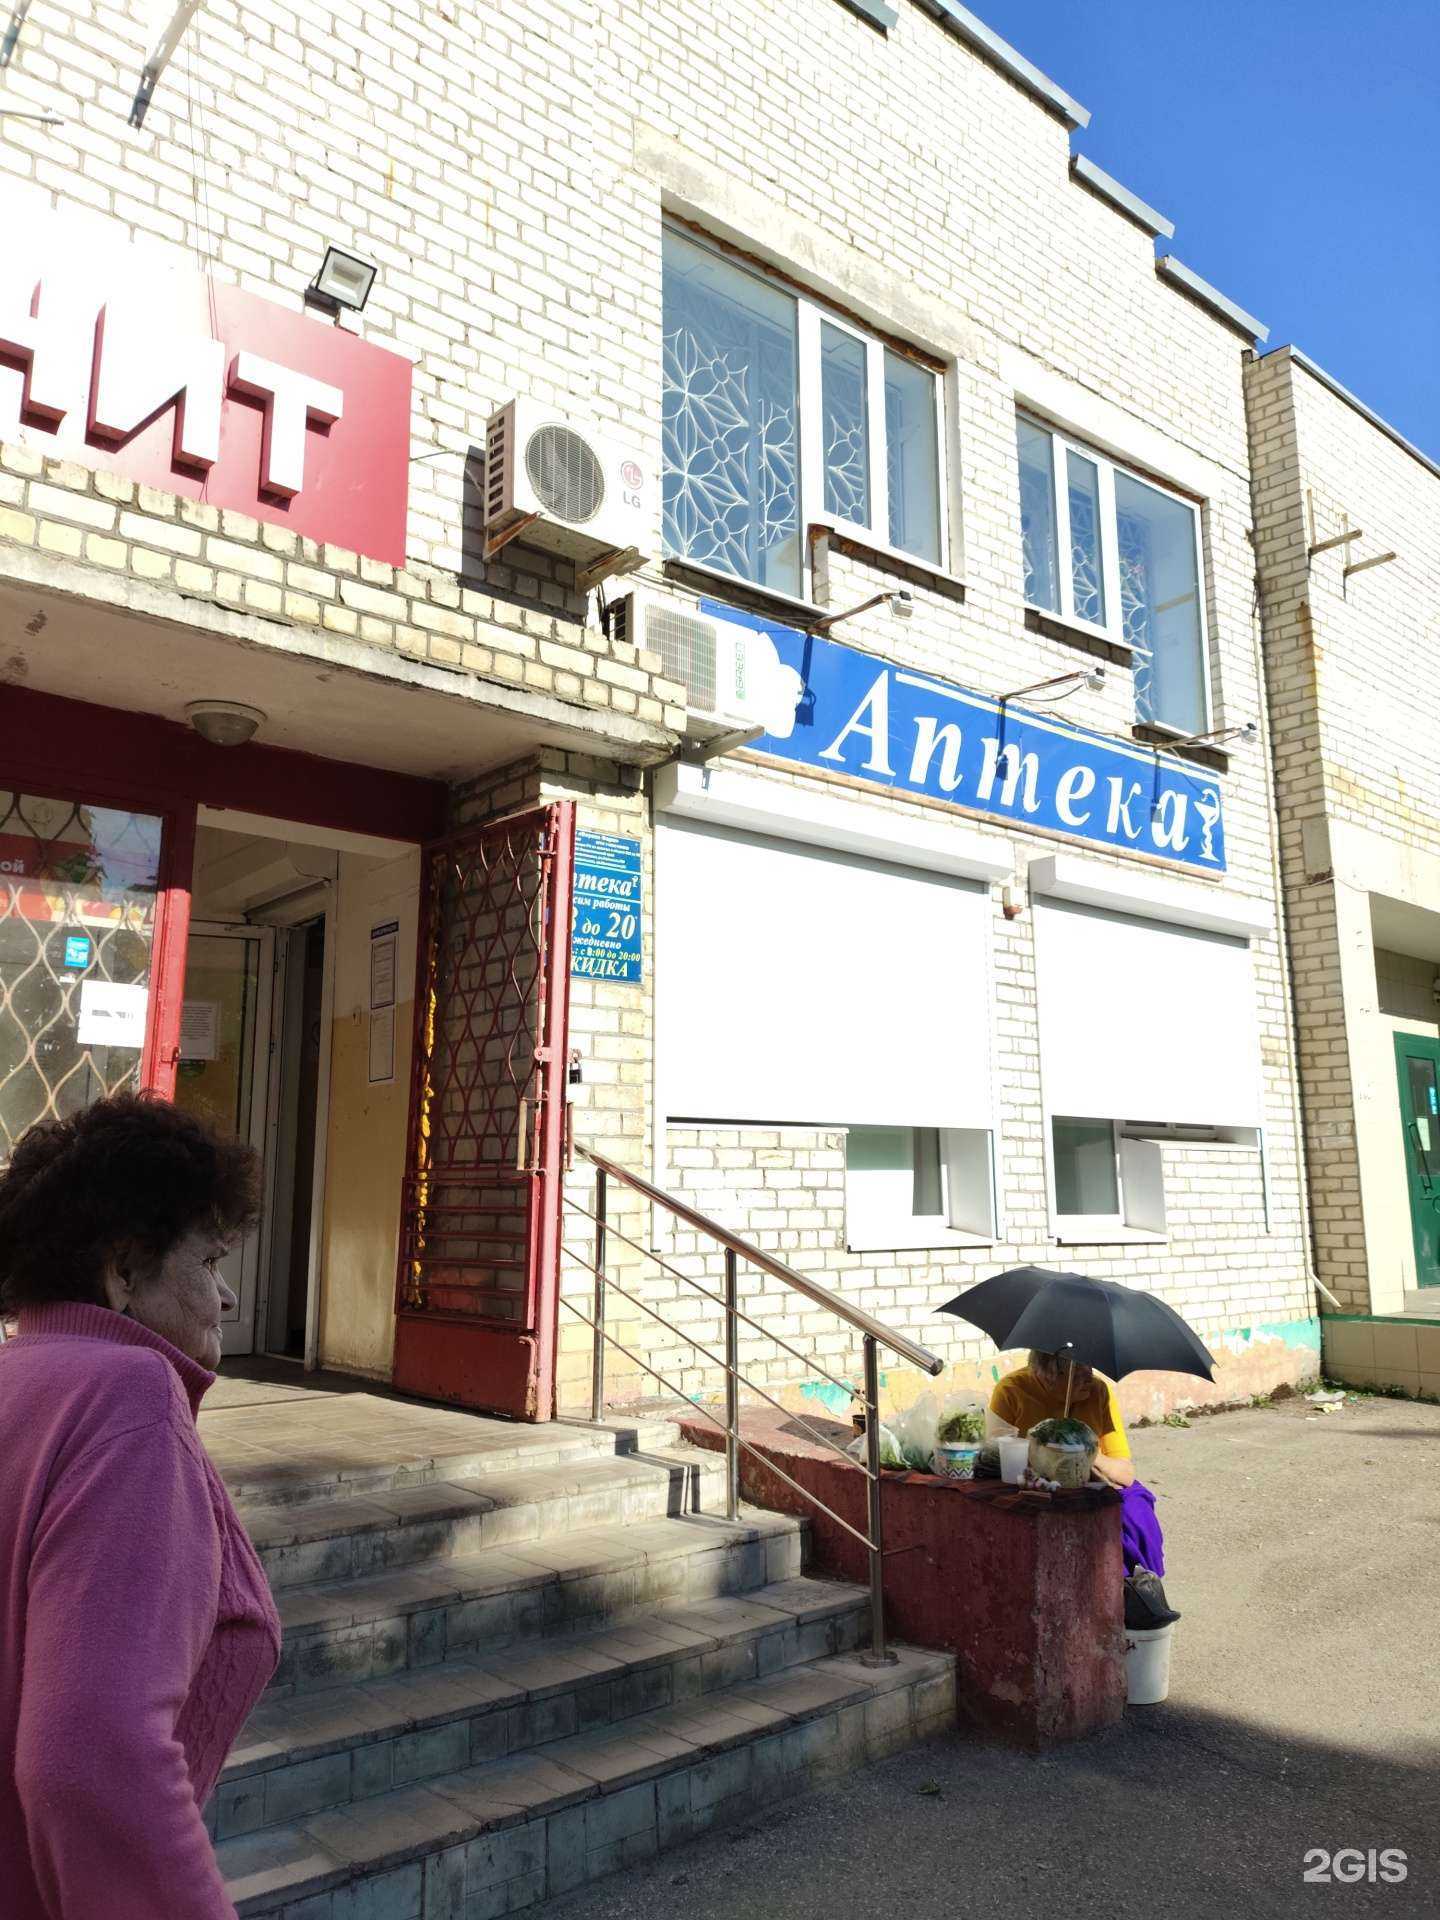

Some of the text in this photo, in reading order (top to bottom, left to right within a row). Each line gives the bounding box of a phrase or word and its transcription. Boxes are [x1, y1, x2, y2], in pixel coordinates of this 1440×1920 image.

[623, 490, 641, 509] LG
[818, 669, 1190, 851] Аптека
[592, 898, 631, 912] работы
[582, 917, 601, 936] до
[606, 911, 637, 940] 20
